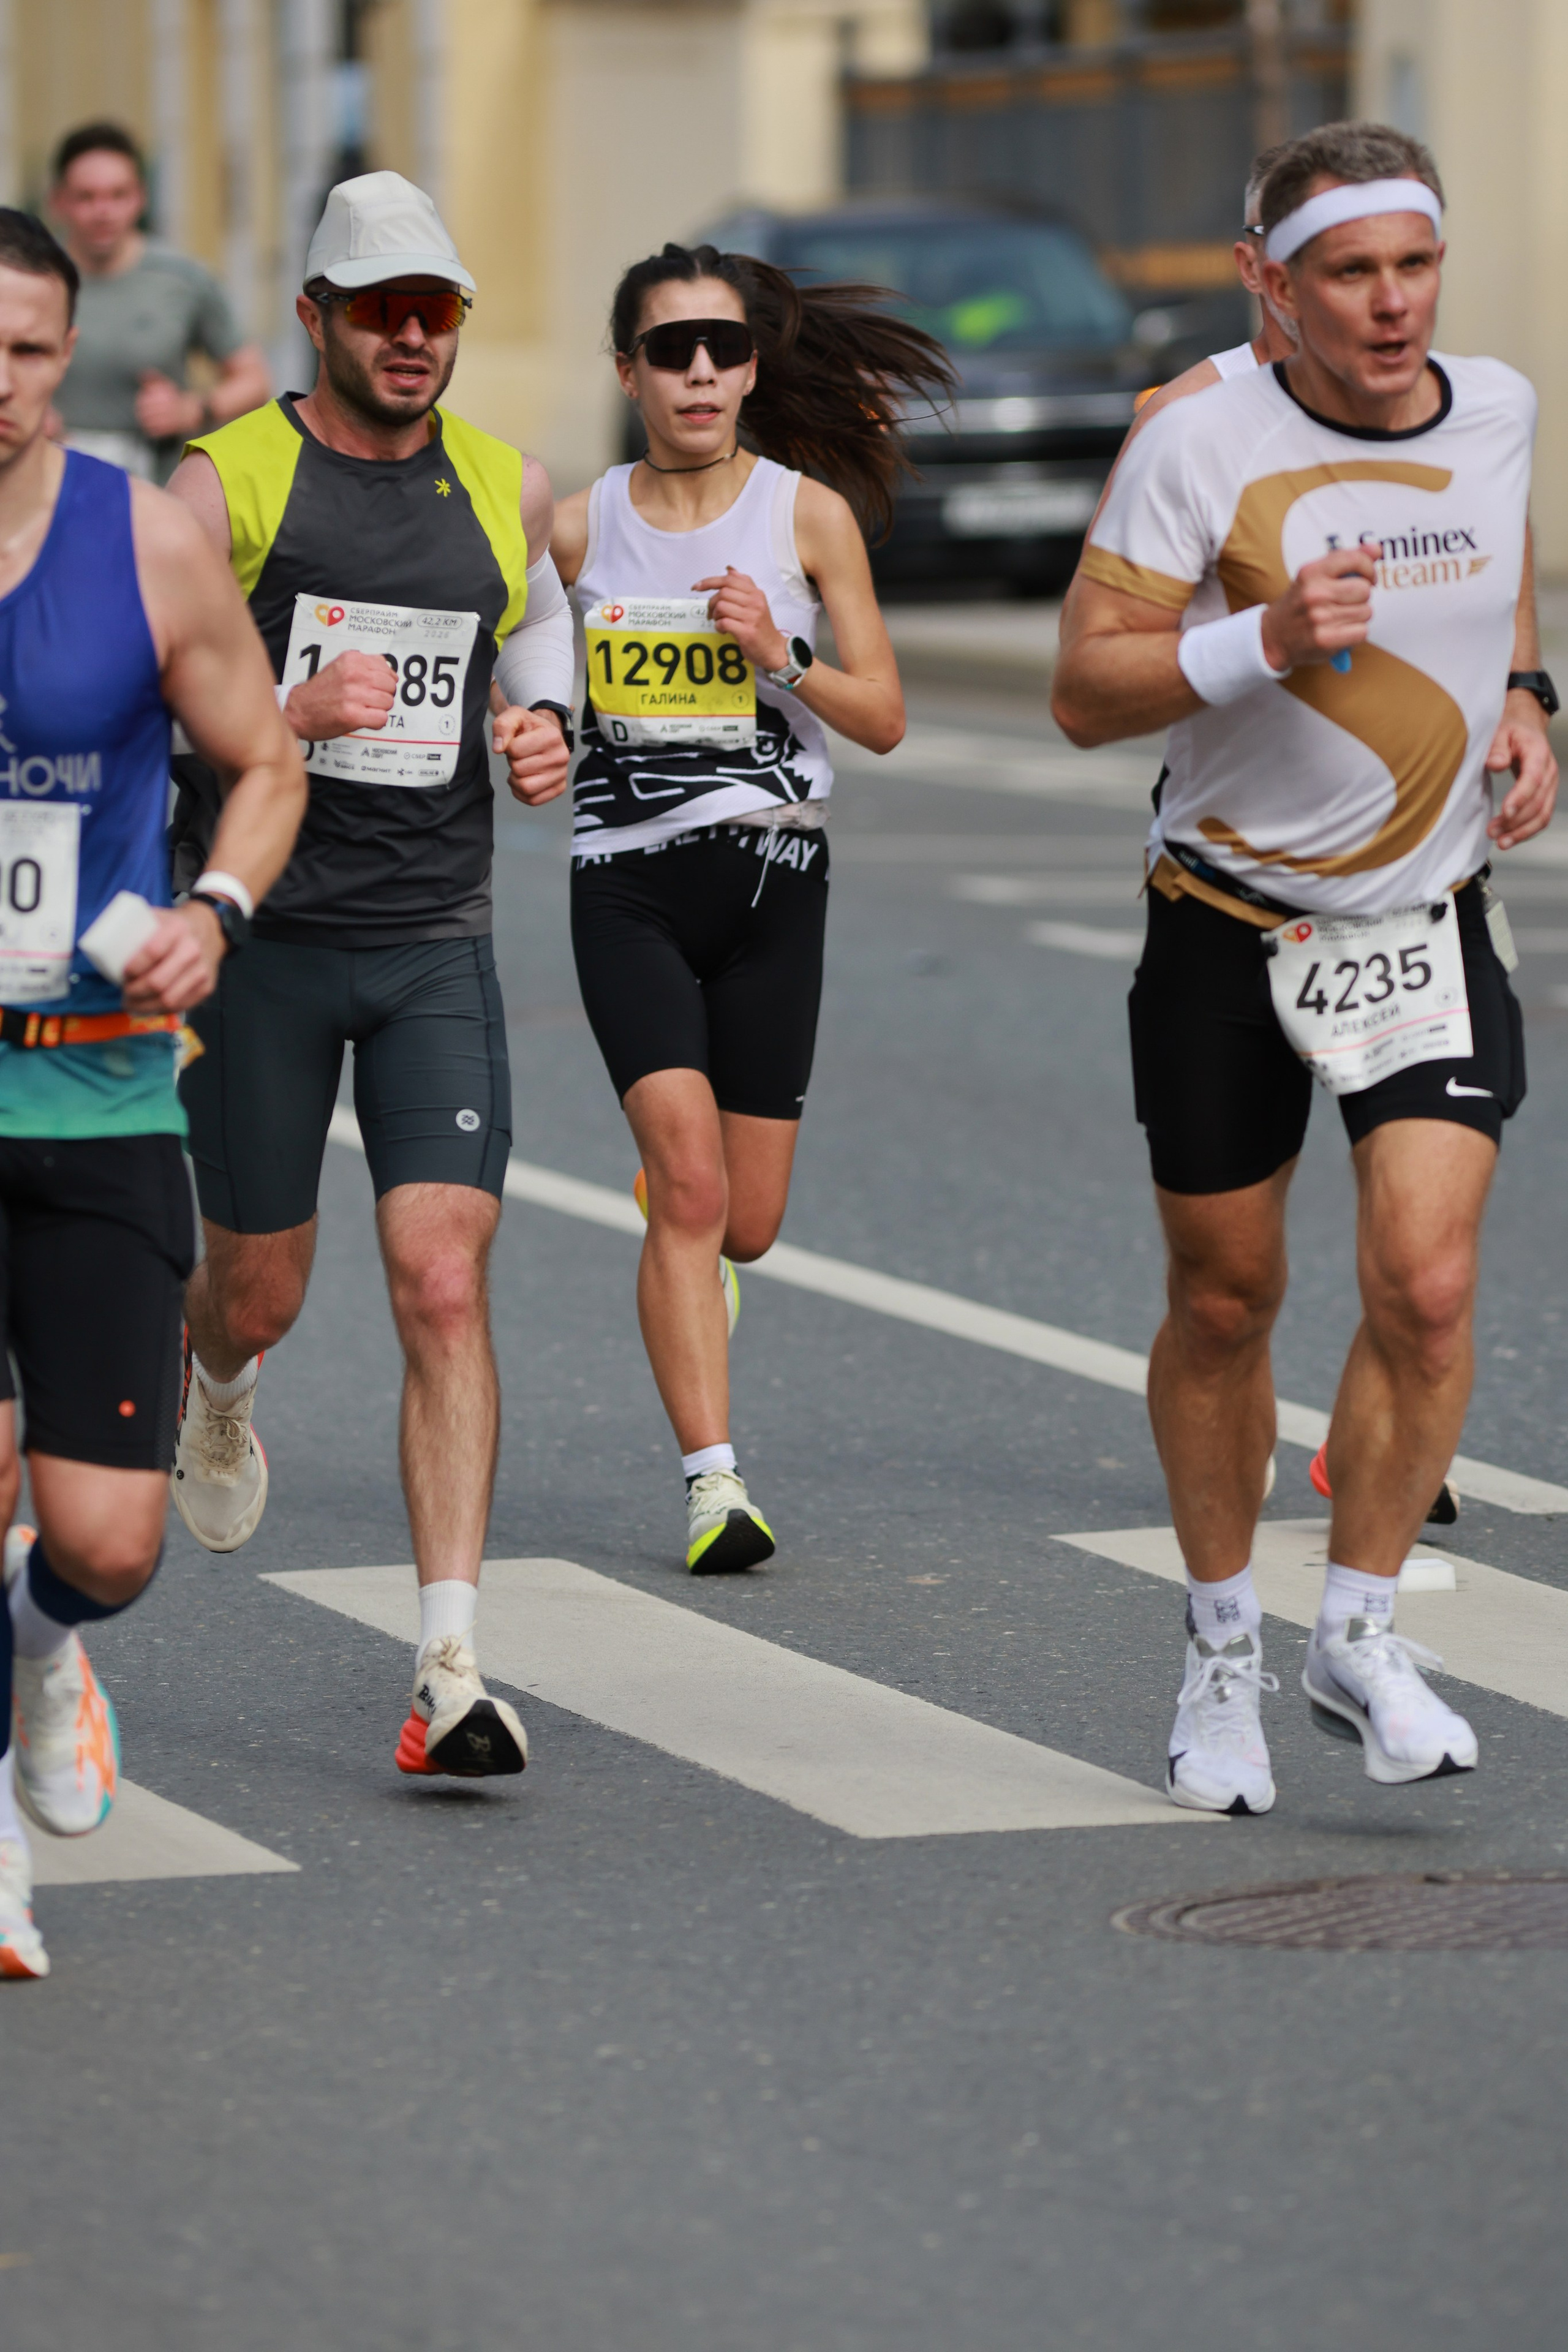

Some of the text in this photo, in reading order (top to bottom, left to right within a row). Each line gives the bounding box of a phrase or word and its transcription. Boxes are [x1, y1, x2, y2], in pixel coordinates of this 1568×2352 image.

[1379, 558, 1461, 590] team
[349, 614, 413, 628] МОСКОВСКИЙ
[350, 606, 399, 617] СБЕРПРАЙМ
[347, 624, 396, 635] МАРАФОН
[595, 639, 747, 686] 12908
[299, 643, 460, 707] 185
[641, 693, 697, 705] ГАЛИНА
[611, 720, 628, 742] D
[1296, 943, 1432, 1015] 4235
